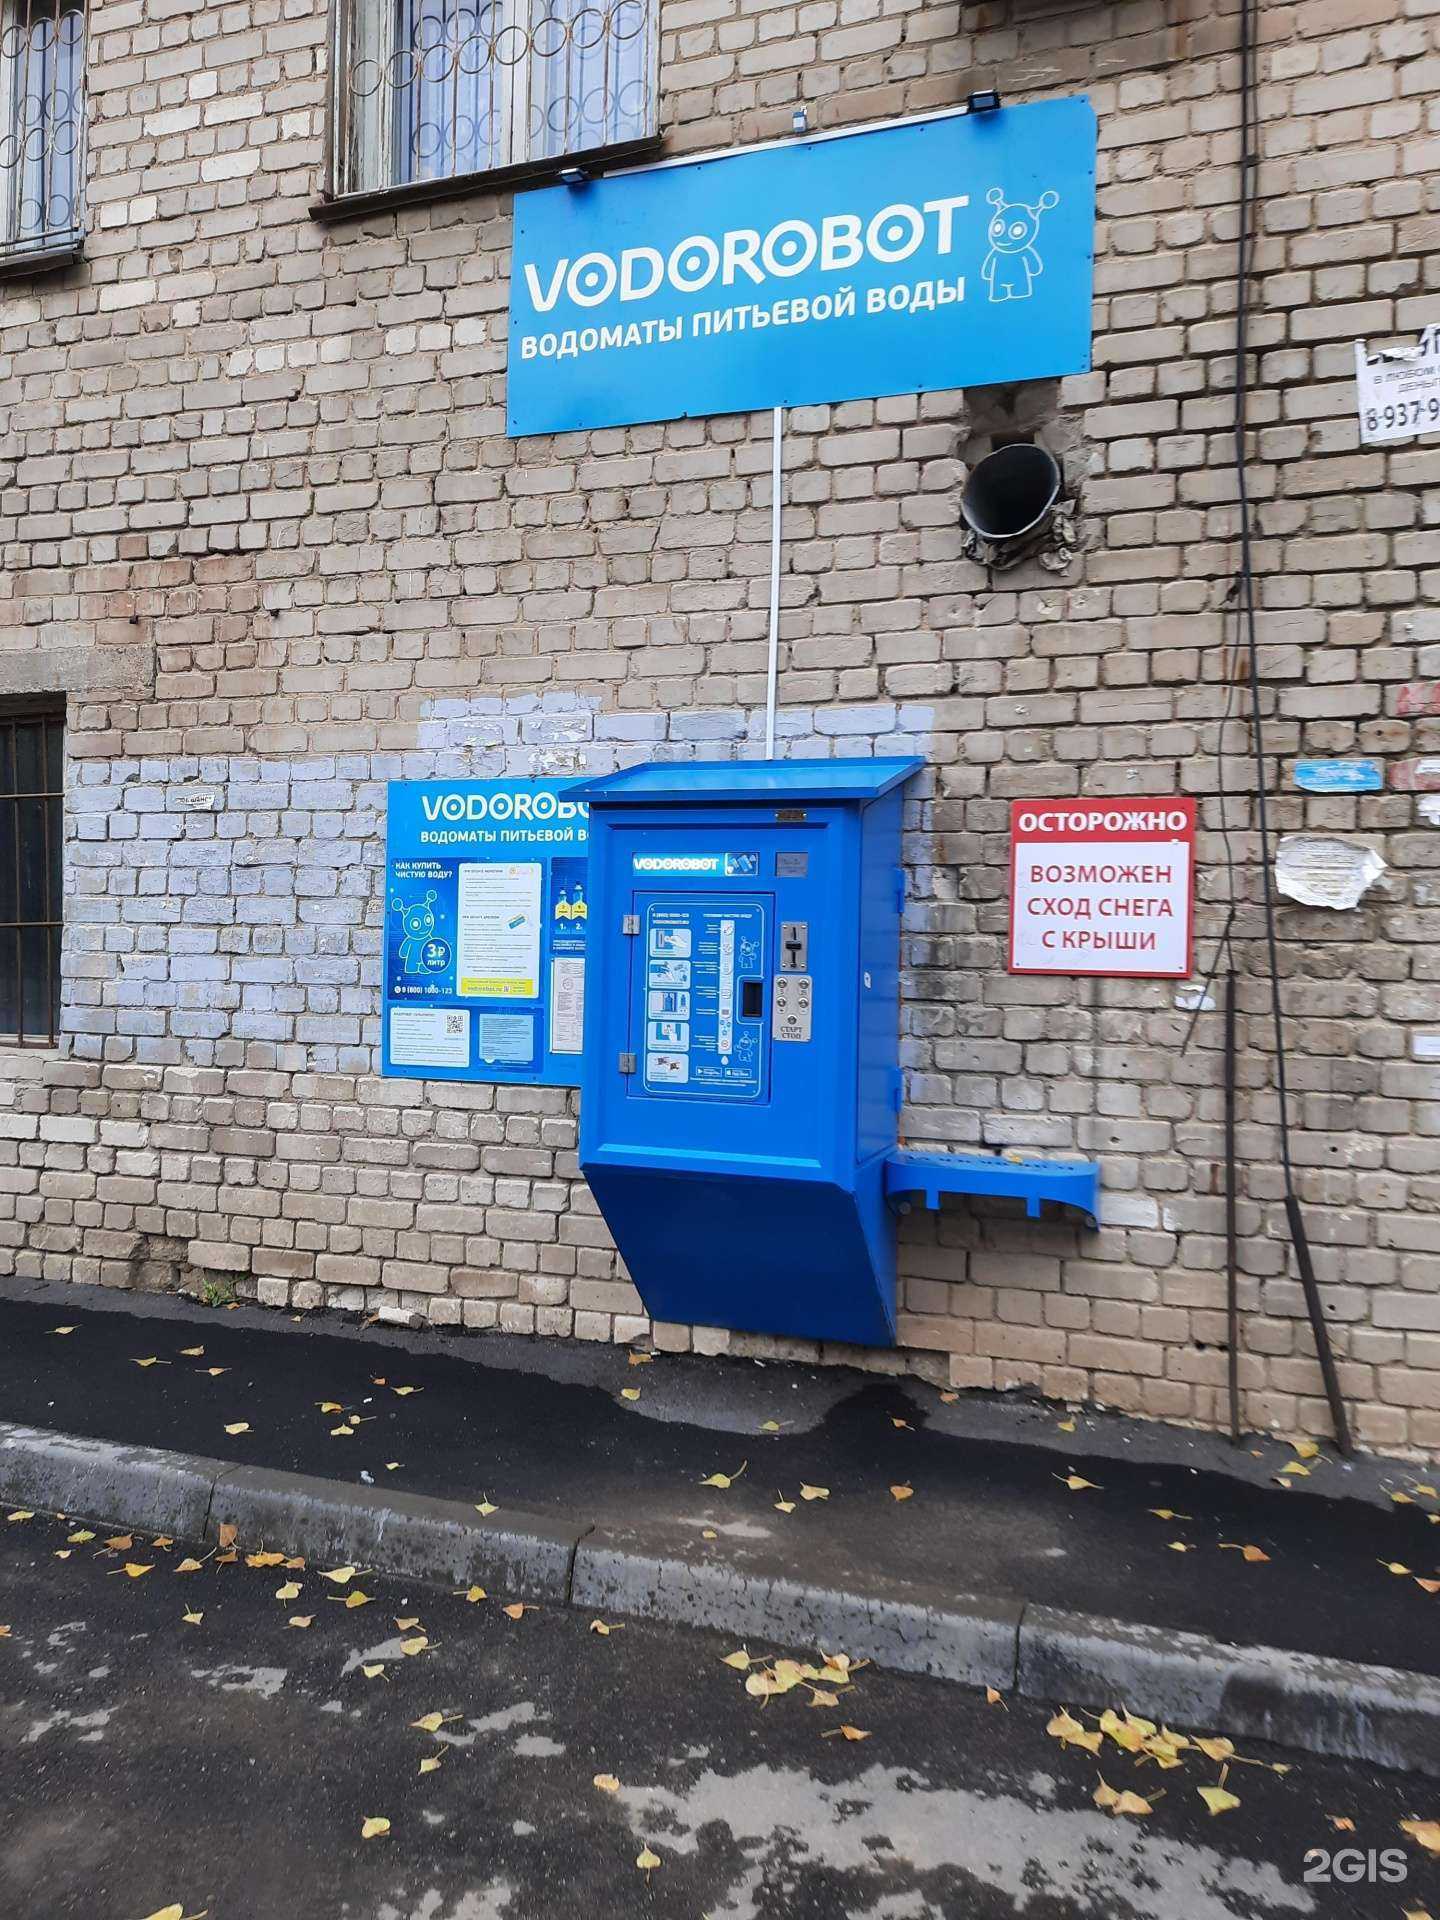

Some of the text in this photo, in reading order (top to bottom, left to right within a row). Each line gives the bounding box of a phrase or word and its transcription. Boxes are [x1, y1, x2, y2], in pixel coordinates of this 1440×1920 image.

[523, 195, 970, 312] VODOROBOT
[521, 276, 966, 360] ВОДОМАТЫ ПИТЬЕВОЙ ВОДЫ
[1018, 811, 1188, 832] ОСТОРОЖНО
[420, 829, 496, 845] ВОДОМАТЫ
[500, 826, 574, 843] ПИТЬЕВОЙ
[395, 861, 442, 870] КАК КУПИТЬ
[633, 857, 720, 871] VODOROBOT
[395, 870, 426, 879] ЧИСТУЮ
[427, 870, 453, 880] ВОДУ?
[1030, 865, 1172, 884] ВОЗМОЖЕН
[1027, 897, 1174, 920] СХОД СНЕГА
[1041, 930, 1156, 950] С КРЫШИ
[427, 959, 446, 968] литр
